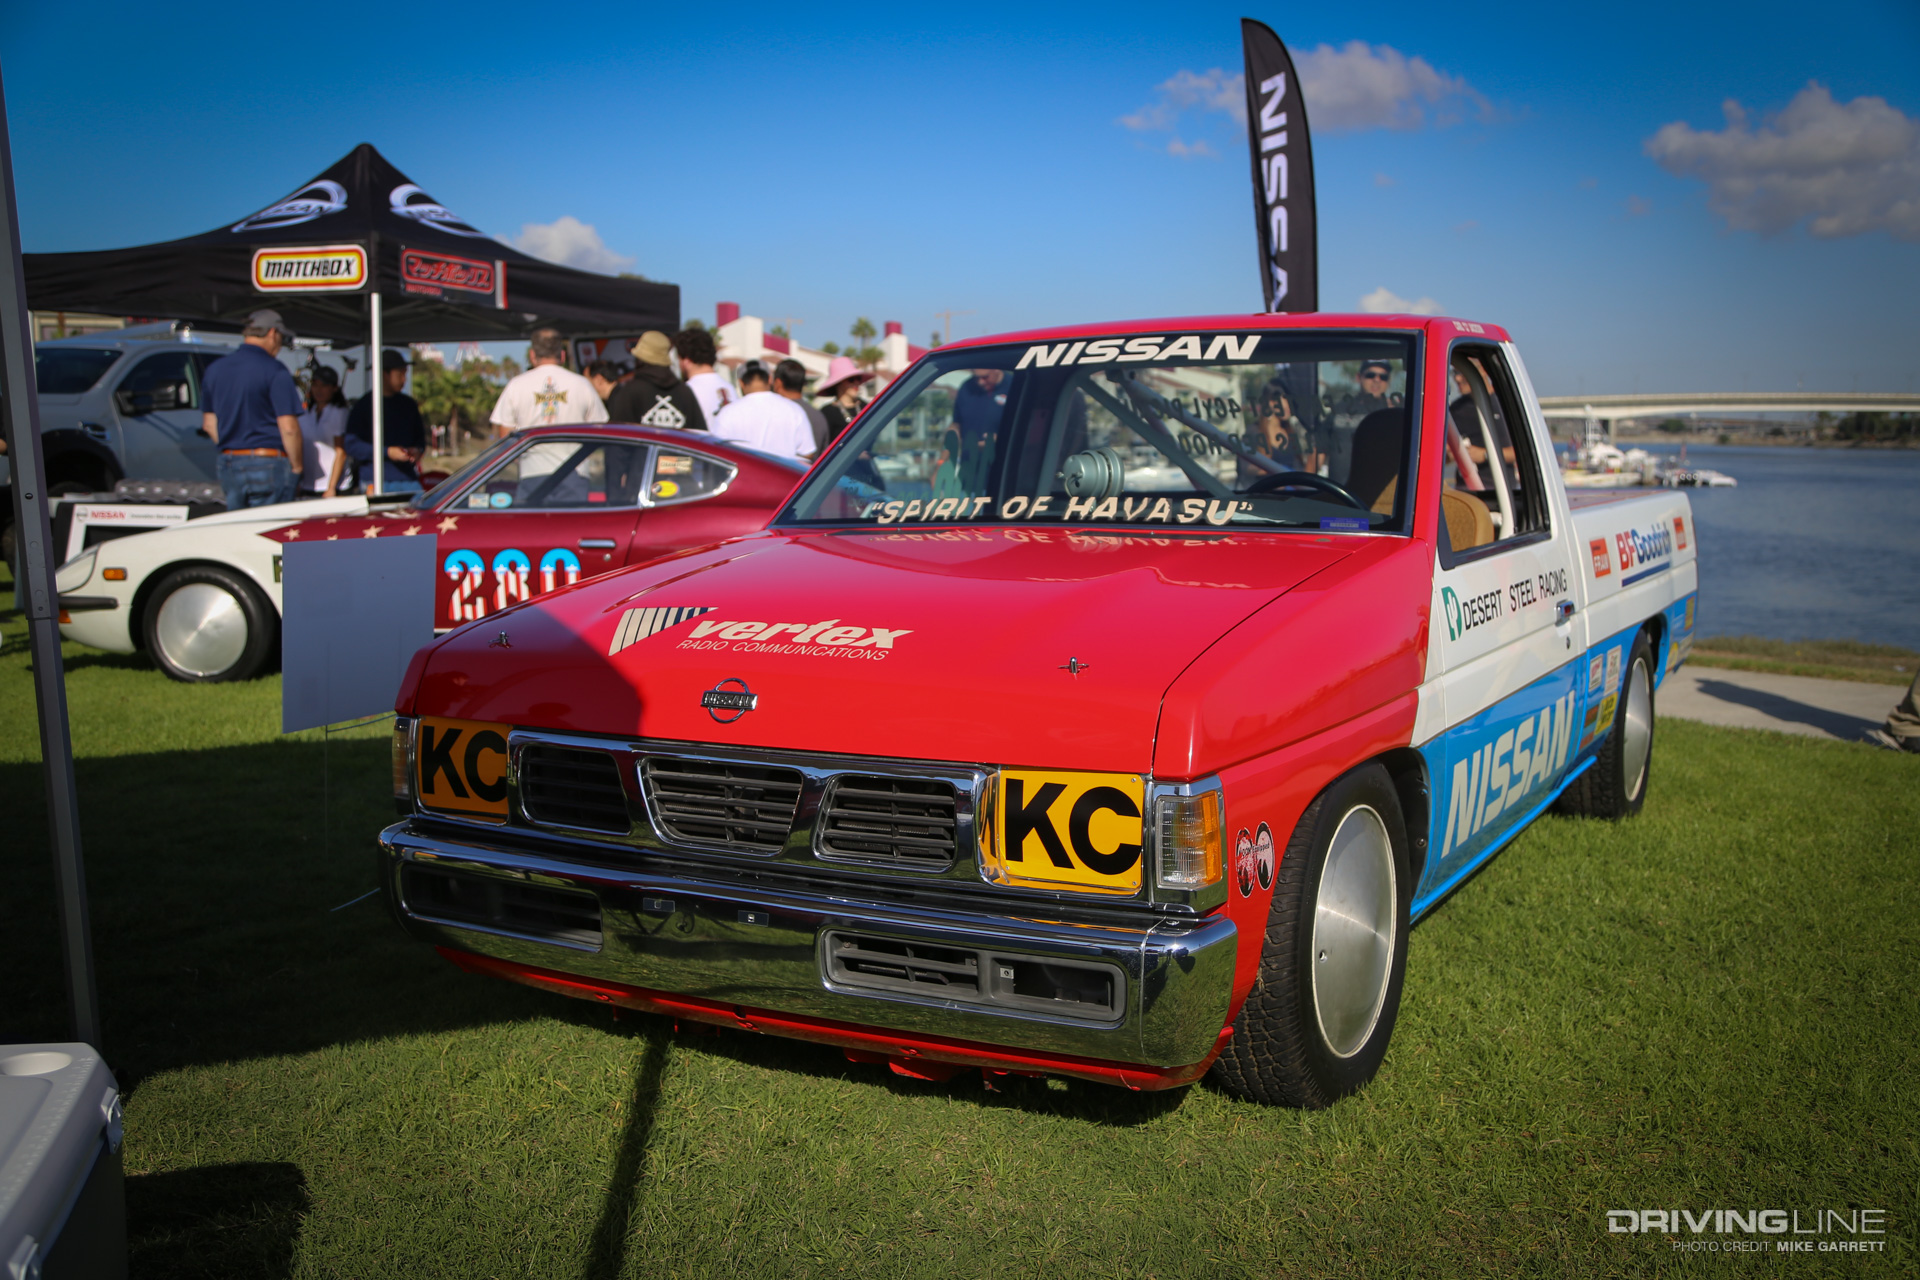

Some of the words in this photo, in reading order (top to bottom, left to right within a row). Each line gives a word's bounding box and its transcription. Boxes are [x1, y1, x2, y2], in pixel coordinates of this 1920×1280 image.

[1259, 71, 1289, 313] NISSA
[264, 256, 357, 279] MATCHBOX
[1015, 335, 1262, 370] NISSAN
[91, 511, 126, 520] NISSAN
[871, 496, 991, 524] “SPIRIT
[1002, 495, 1053, 519] OF
[1615, 521, 1672, 571] BFGoodrich
[444, 548, 583, 622] 280
[1462, 588, 1503, 631] DESERT
[1509, 578, 1537, 612] STEEL
[1538, 568, 1568, 599] RACING
[676, 639, 730, 651] RADIO
[731, 641, 889, 661] COMMUNICATIONS
[688, 619, 914, 649] vertex
[703, 692, 754, 708] NISSAN
[421, 725, 508, 803] KC
[1440, 689, 1575, 859] NISSAN
[1005, 777, 1143, 875] KC
